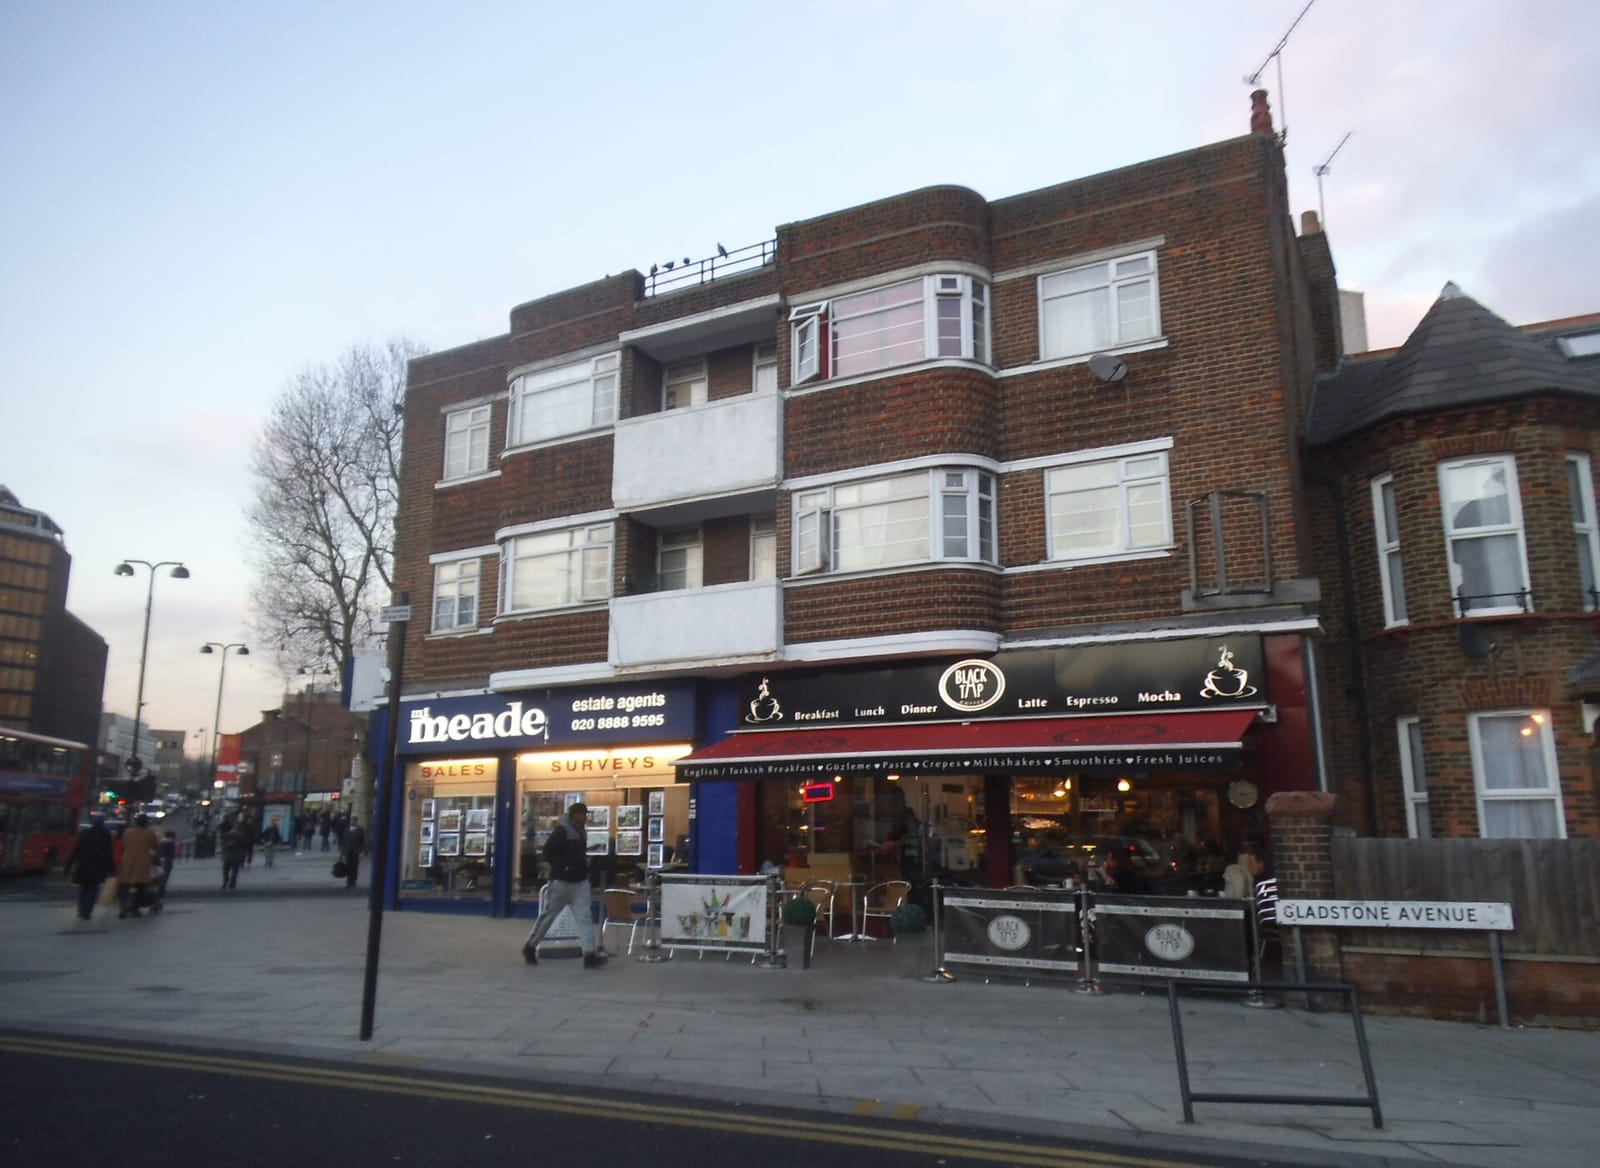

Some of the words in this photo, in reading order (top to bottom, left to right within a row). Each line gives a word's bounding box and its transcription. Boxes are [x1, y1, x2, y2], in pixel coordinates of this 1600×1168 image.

[955, 668, 987, 685] BLACK
[959, 682, 984, 699] TAP
[572, 695, 614, 712] estate
[617, 692, 666, 712] agents
[794, 709, 839, 721] Breakfast
[854, 705, 885, 717] Lunch
[901, 703, 938, 715] Dinner
[1018, 698, 1048, 709] Latte
[1066, 695, 1118, 709] Espresso
[1137, 690, 1181, 703] Mocha
[408, 701, 546, 744] meade
[571, 718, 595, 731] 020
[597, 716, 630, 730] 8888
[631, 714, 665, 728] 9595
[421, 764, 485, 778] SALES
[551, 756, 654, 773] SURVEYS
[684, 764, 719, 778] English
[729, 763, 764, 775] Turkish
[767, 763, 815, 774] Breakfast
[882, 760, 911, 770] Pasta
[922, 759, 961, 770] Crepes
[973, 757, 1041, 768] Milkshakes
[1054, 755, 1122, 766] Smoothies
[1136, 754, 1173, 765] Fresh
[1178, 754, 1224, 765] Juices
[1283, 905, 1390, 920] GLADSTONE
[1398, 907, 1477, 922] AVENUE
